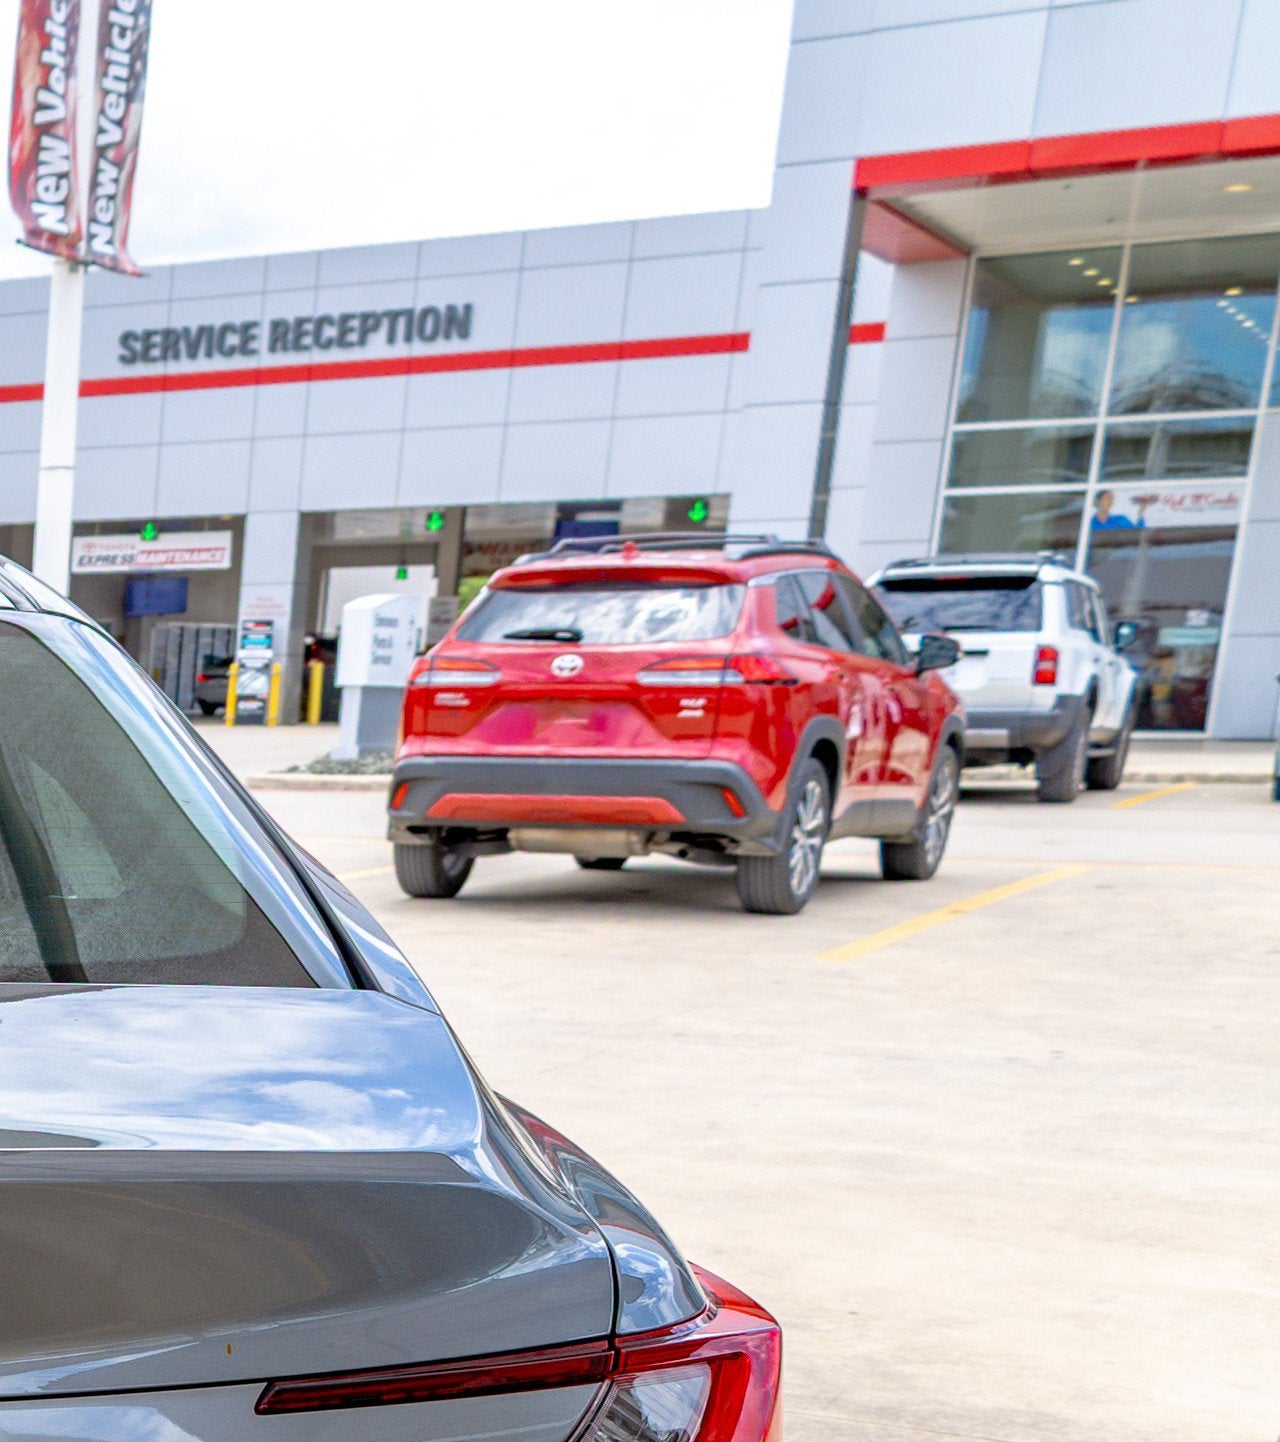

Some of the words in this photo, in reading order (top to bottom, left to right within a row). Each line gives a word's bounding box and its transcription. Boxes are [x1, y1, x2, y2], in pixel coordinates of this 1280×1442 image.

[31, 133, 71, 236] New
[90, 158, 120, 254] New
[118, 320, 261, 365] SERVICE
[267, 302, 474, 353] RECEPTION
[77, 552, 135, 567] EXPRESS
